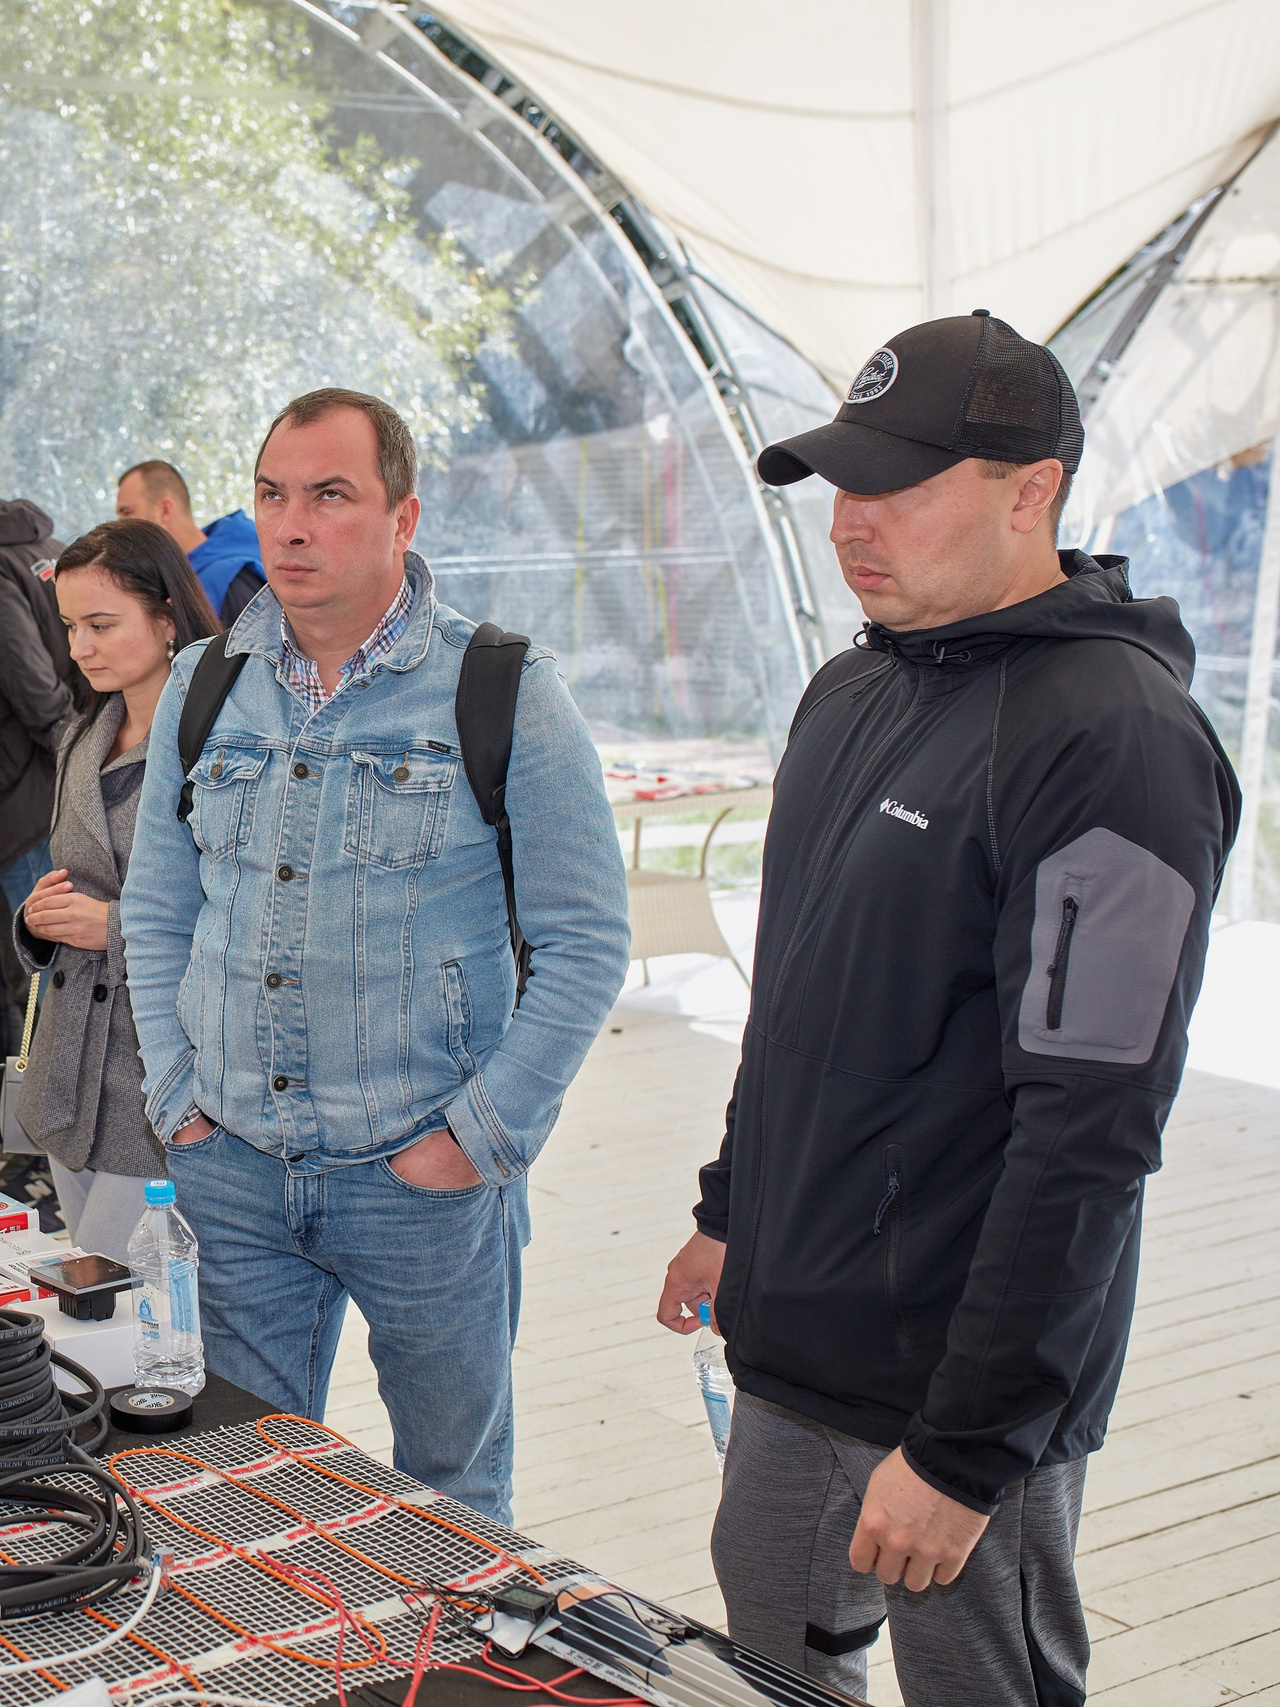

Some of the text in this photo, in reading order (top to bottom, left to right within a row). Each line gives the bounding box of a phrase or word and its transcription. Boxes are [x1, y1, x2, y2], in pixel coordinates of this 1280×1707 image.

[885, 800, 929, 830] Columbia
[4, 1331, 15, 1339] 230
[26, 1456, 48, 1467] КАБЕЛЬ
